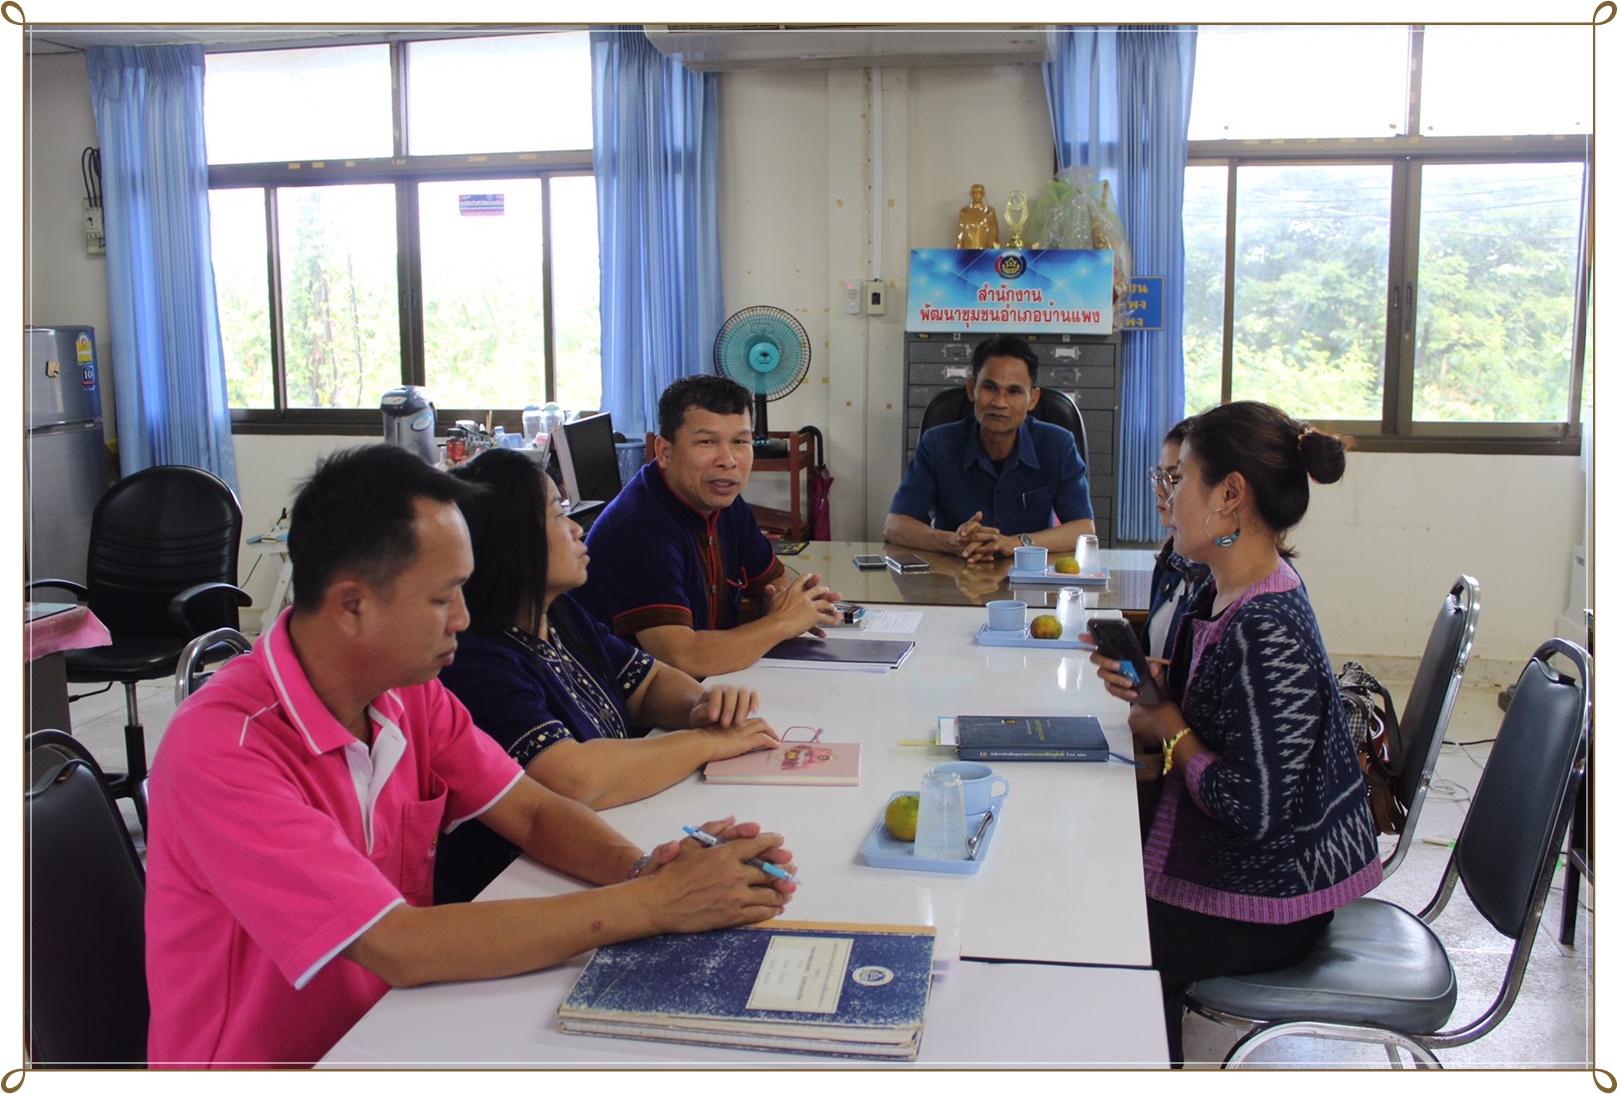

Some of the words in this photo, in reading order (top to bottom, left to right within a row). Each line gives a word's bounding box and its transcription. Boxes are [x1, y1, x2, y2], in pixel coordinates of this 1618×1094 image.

[978, 283, 1042, 302] สำนักงาน
[919, 300, 1100, 328] พัฒนาชุมชนอำเภอบ้านแพง
[83, 369, 93, 380] 10
